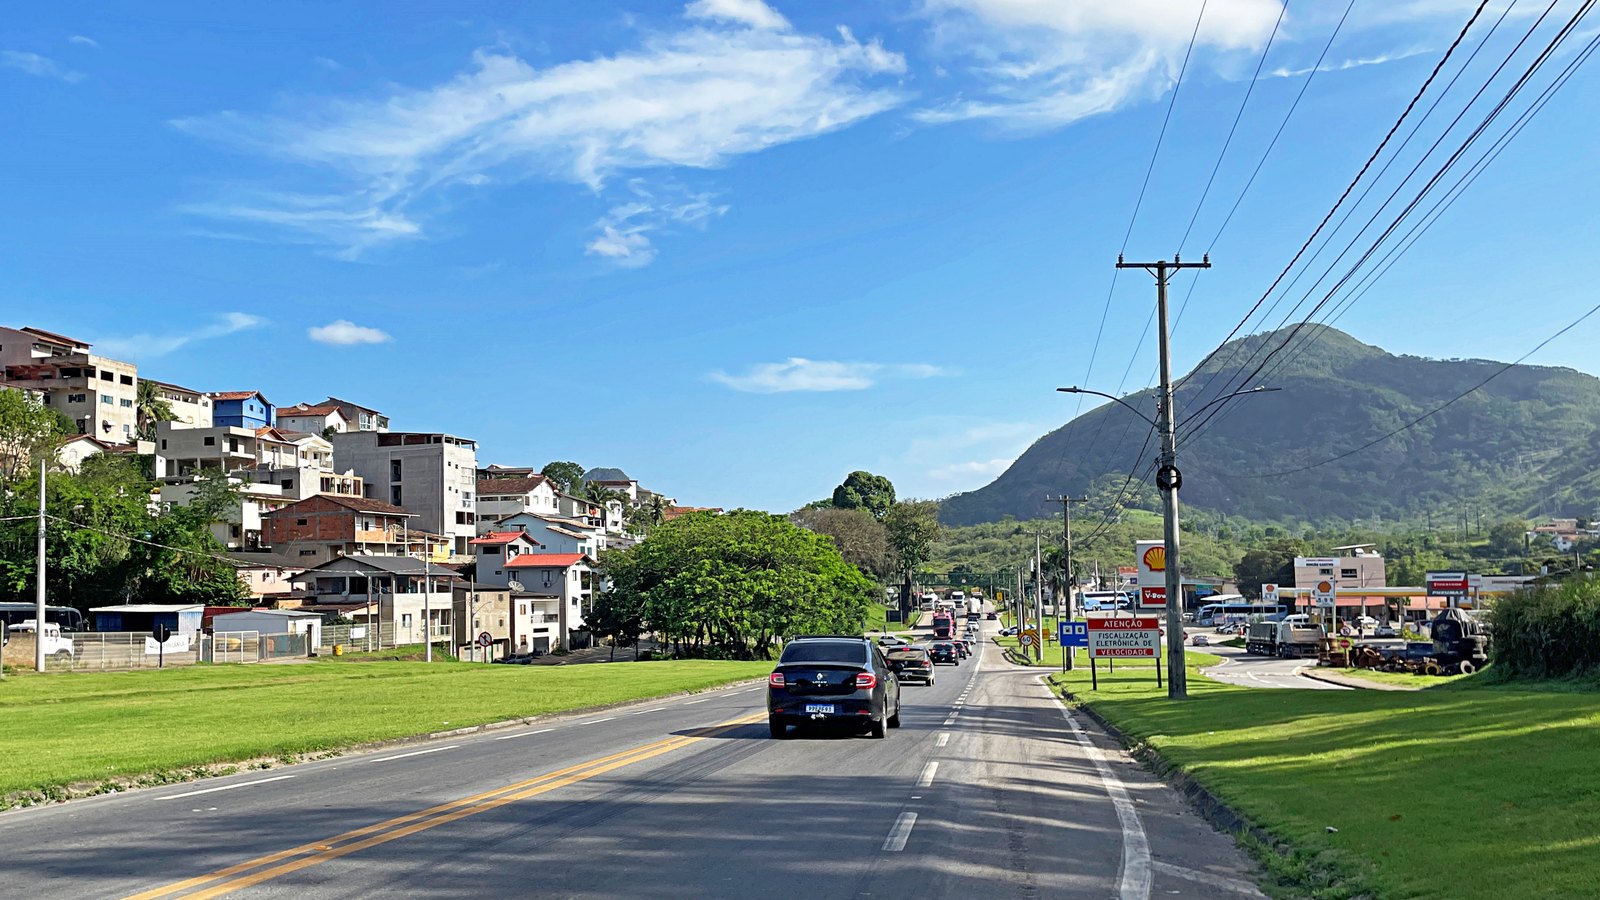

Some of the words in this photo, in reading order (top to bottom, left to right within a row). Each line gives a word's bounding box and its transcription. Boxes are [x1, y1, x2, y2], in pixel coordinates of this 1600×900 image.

[1103, 620, 1143, 628] ATENÇÃO
[1098, 632, 1149, 640] FISCALIZAÇÃO
[1096, 639, 1140, 647] ELETRÔNICA
